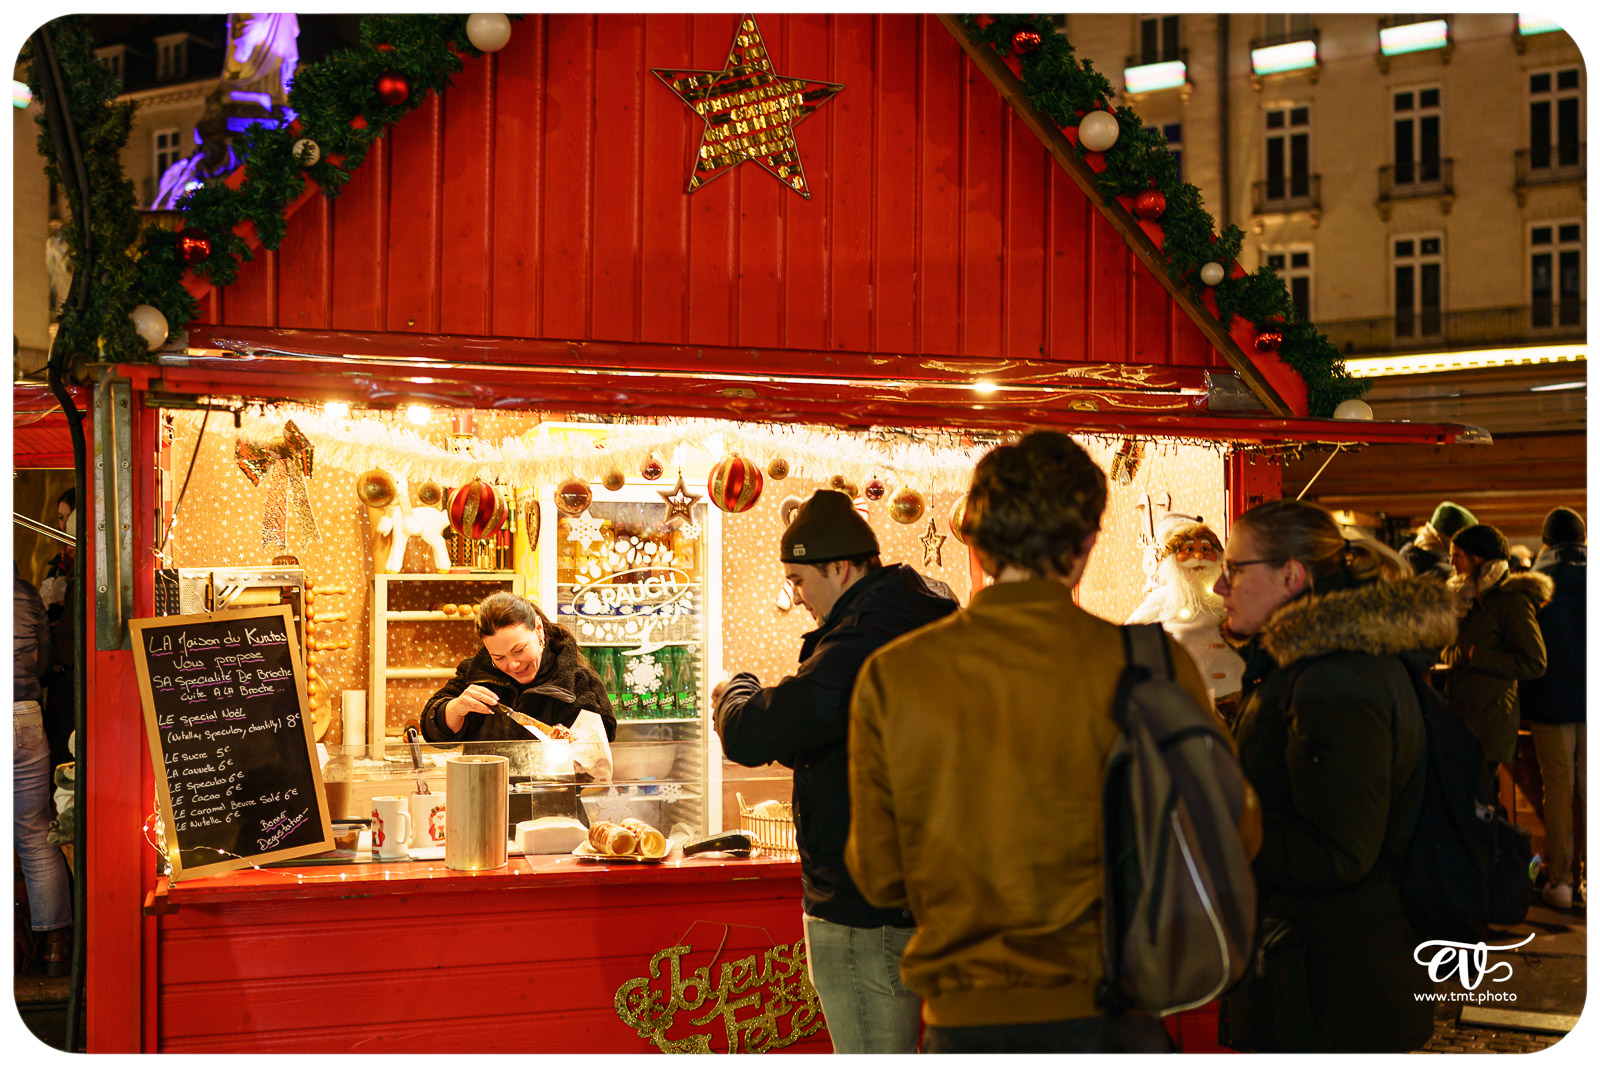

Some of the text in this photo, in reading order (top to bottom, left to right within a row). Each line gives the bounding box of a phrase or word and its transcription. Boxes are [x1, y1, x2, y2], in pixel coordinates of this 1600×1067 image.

[601, 572, 679, 609] RAUCH
[149, 636, 172, 653] LA
[223, 631, 241, 645] du
[214, 651, 263, 673] propose
[153, 675, 172, 688] SA
[257, 667, 293, 680] Brioche
[223, 686, 234, 695] LA
[158, 714, 174, 726] LE
[165, 753, 179, 764] LE
[166, 768, 179, 779] LA
[169, 783, 182, 794] LE
[171, 796, 184, 807] LE
[173, 810, 186, 820] LE
[176, 823, 187, 832] LE
